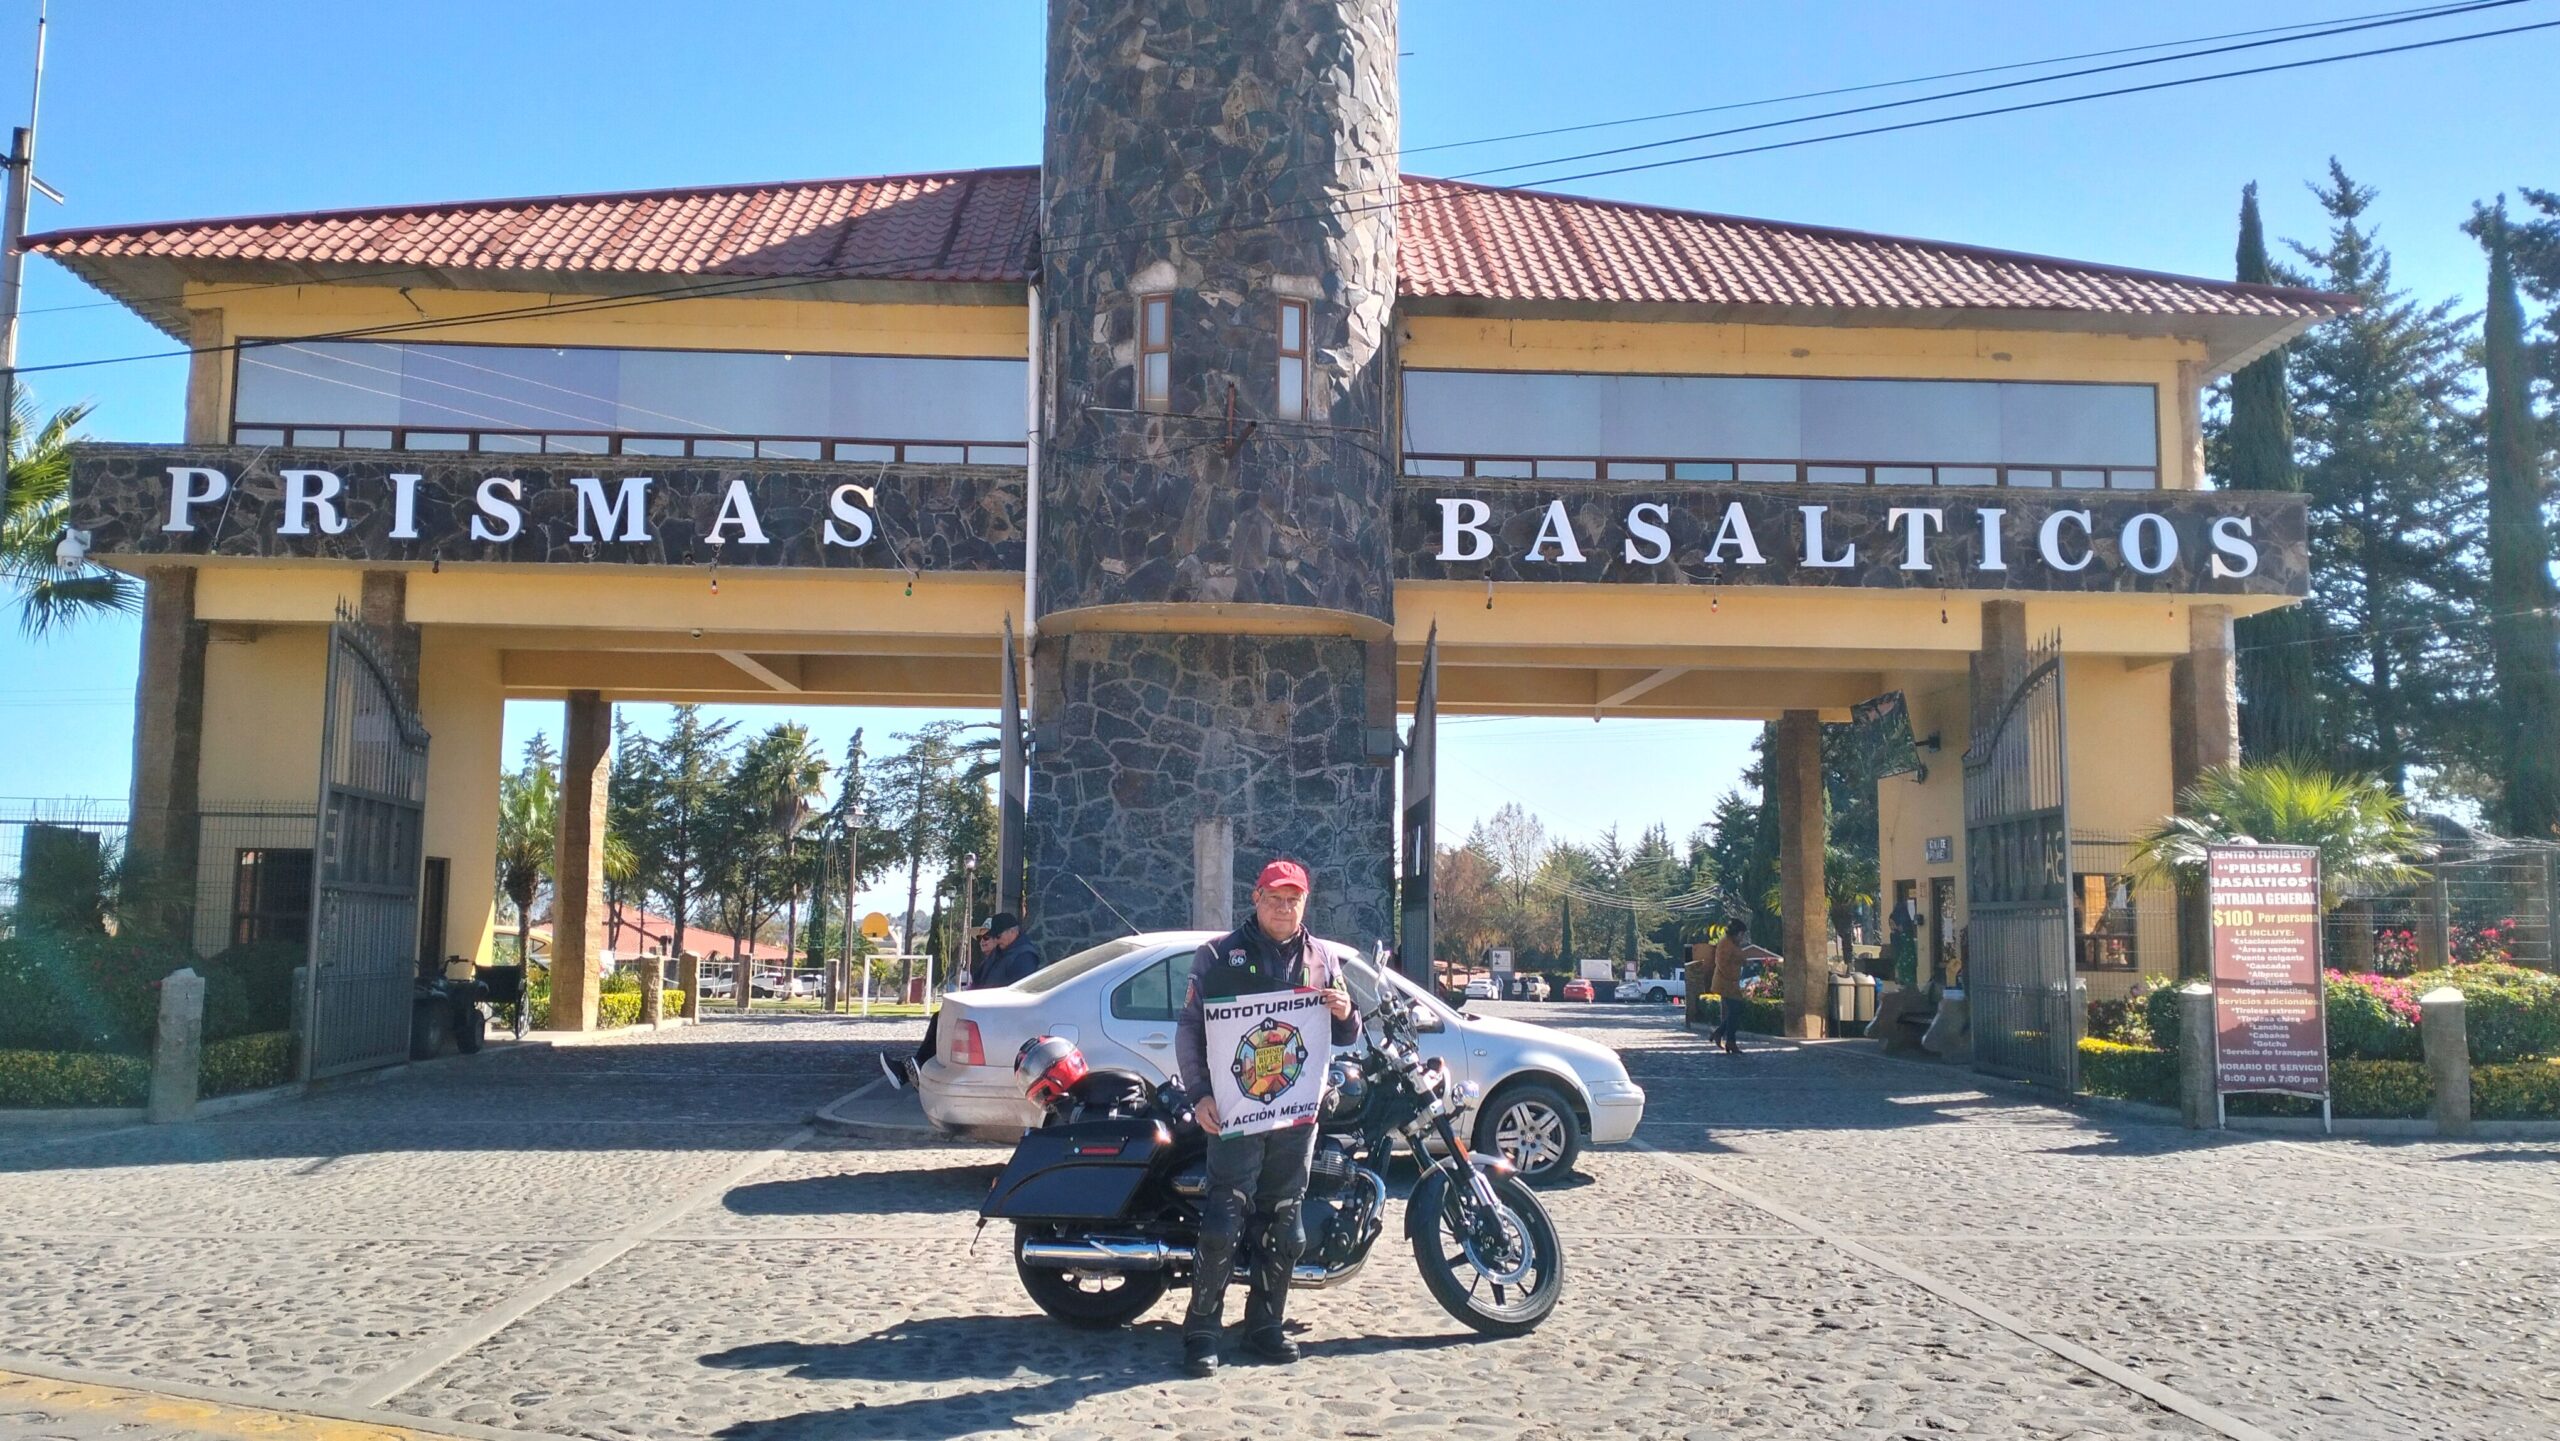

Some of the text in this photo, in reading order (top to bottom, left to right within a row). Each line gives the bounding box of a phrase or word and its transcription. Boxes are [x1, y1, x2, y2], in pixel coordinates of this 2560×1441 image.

[161, 466, 2261, 581] PRISMAS BASALTICOS
[2211, 849, 2316, 859] CENTRO TURÍSTICO
[2212, 892, 2316, 905] ENTRADA GENERAL
[2213, 909, 2320, 927] $100 Por persona
[1231, 954, 1244, 966] 66
[2267, 955, 2305, 963] colgante
[1206, 995, 1327, 1021] MOTOTURISMO
[1264, 1021, 1274, 1029] N
[2274, 1049, 2319, 1057] transporte
[2219, 1063, 2262, 1071] HORARIO
[2280, 1064, 2324, 1072] SERVICIO
[2268, 1074, 2277, 1083] A
[2280, 1075, 2300, 1083] 7:00
[2303, 1076, 2319, 1084] pm
[1233, 1107, 1275, 1127] ACCIÓN
